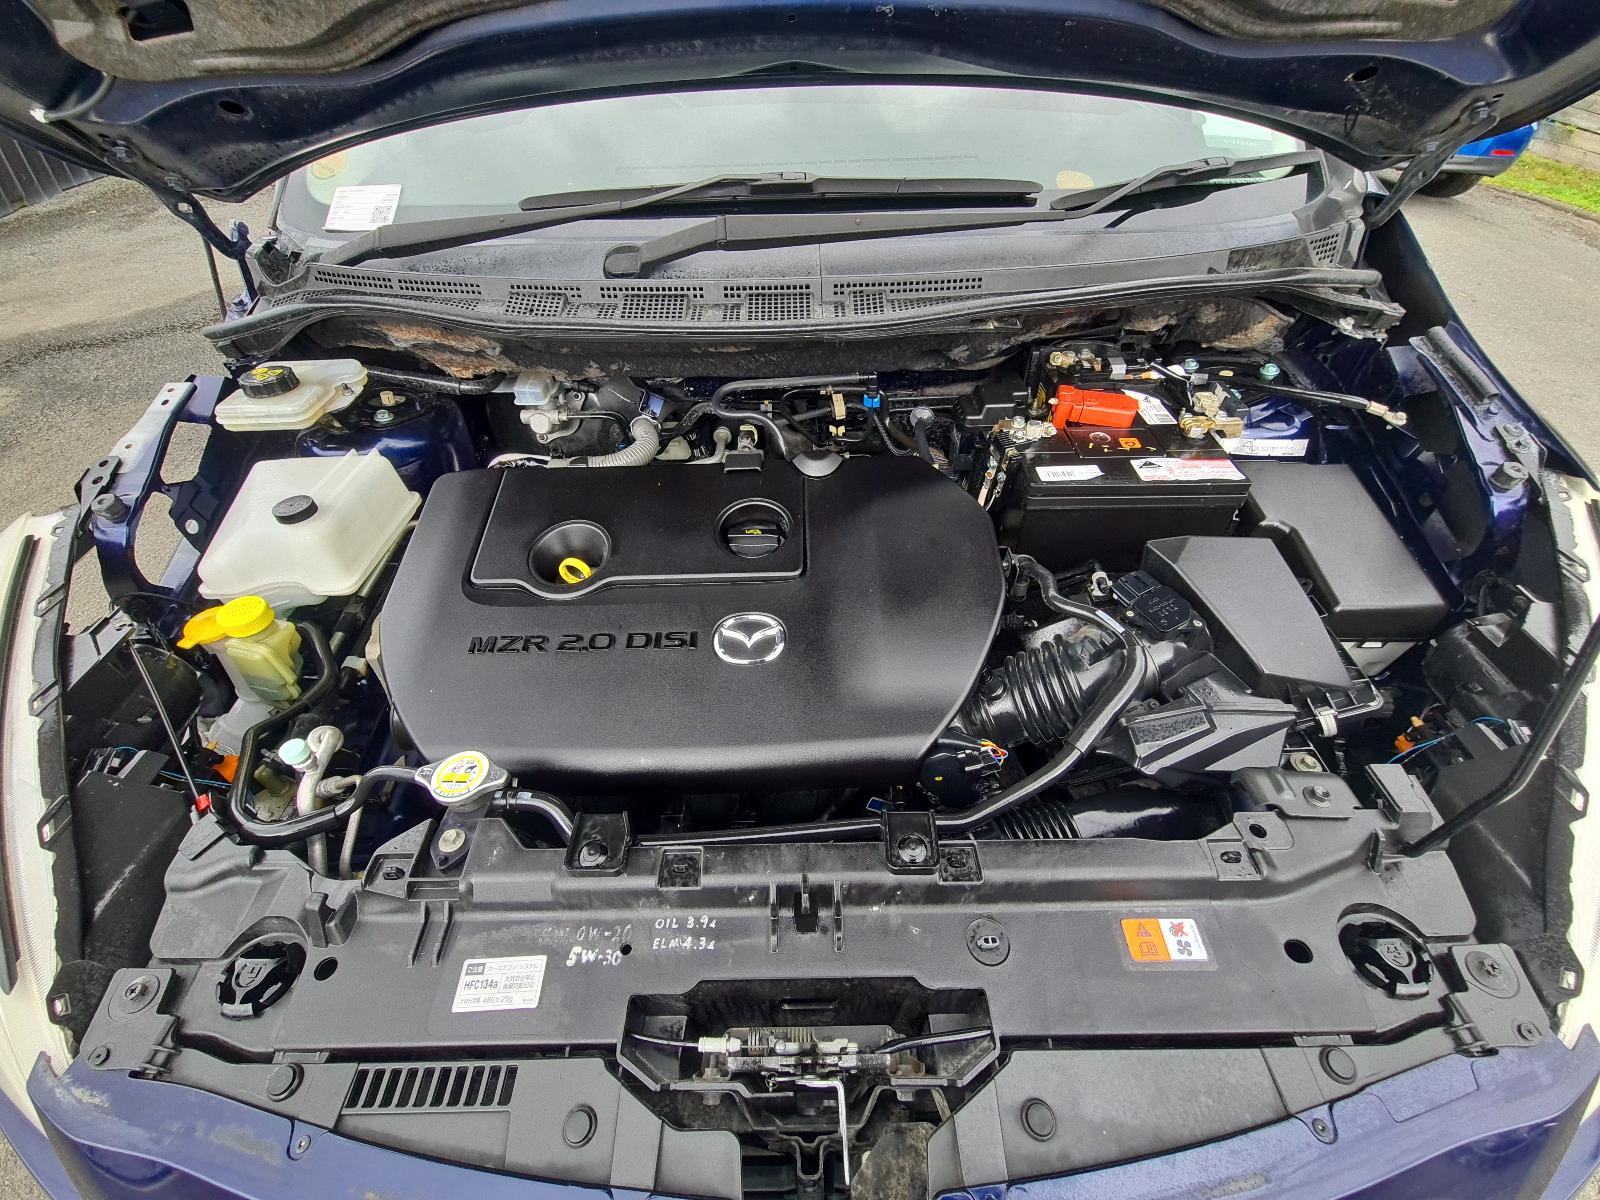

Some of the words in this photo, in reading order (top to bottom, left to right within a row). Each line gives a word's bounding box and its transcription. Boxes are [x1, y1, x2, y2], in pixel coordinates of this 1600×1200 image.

[467, 634, 549, 655] MZR
[556, 632, 617, 652] 2.0
[625, 630, 698, 651] DISI
[655, 917, 679, 929] OIL
[565, 945, 622, 967] 5W-30
[464, 979, 498, 991] HFC134a
